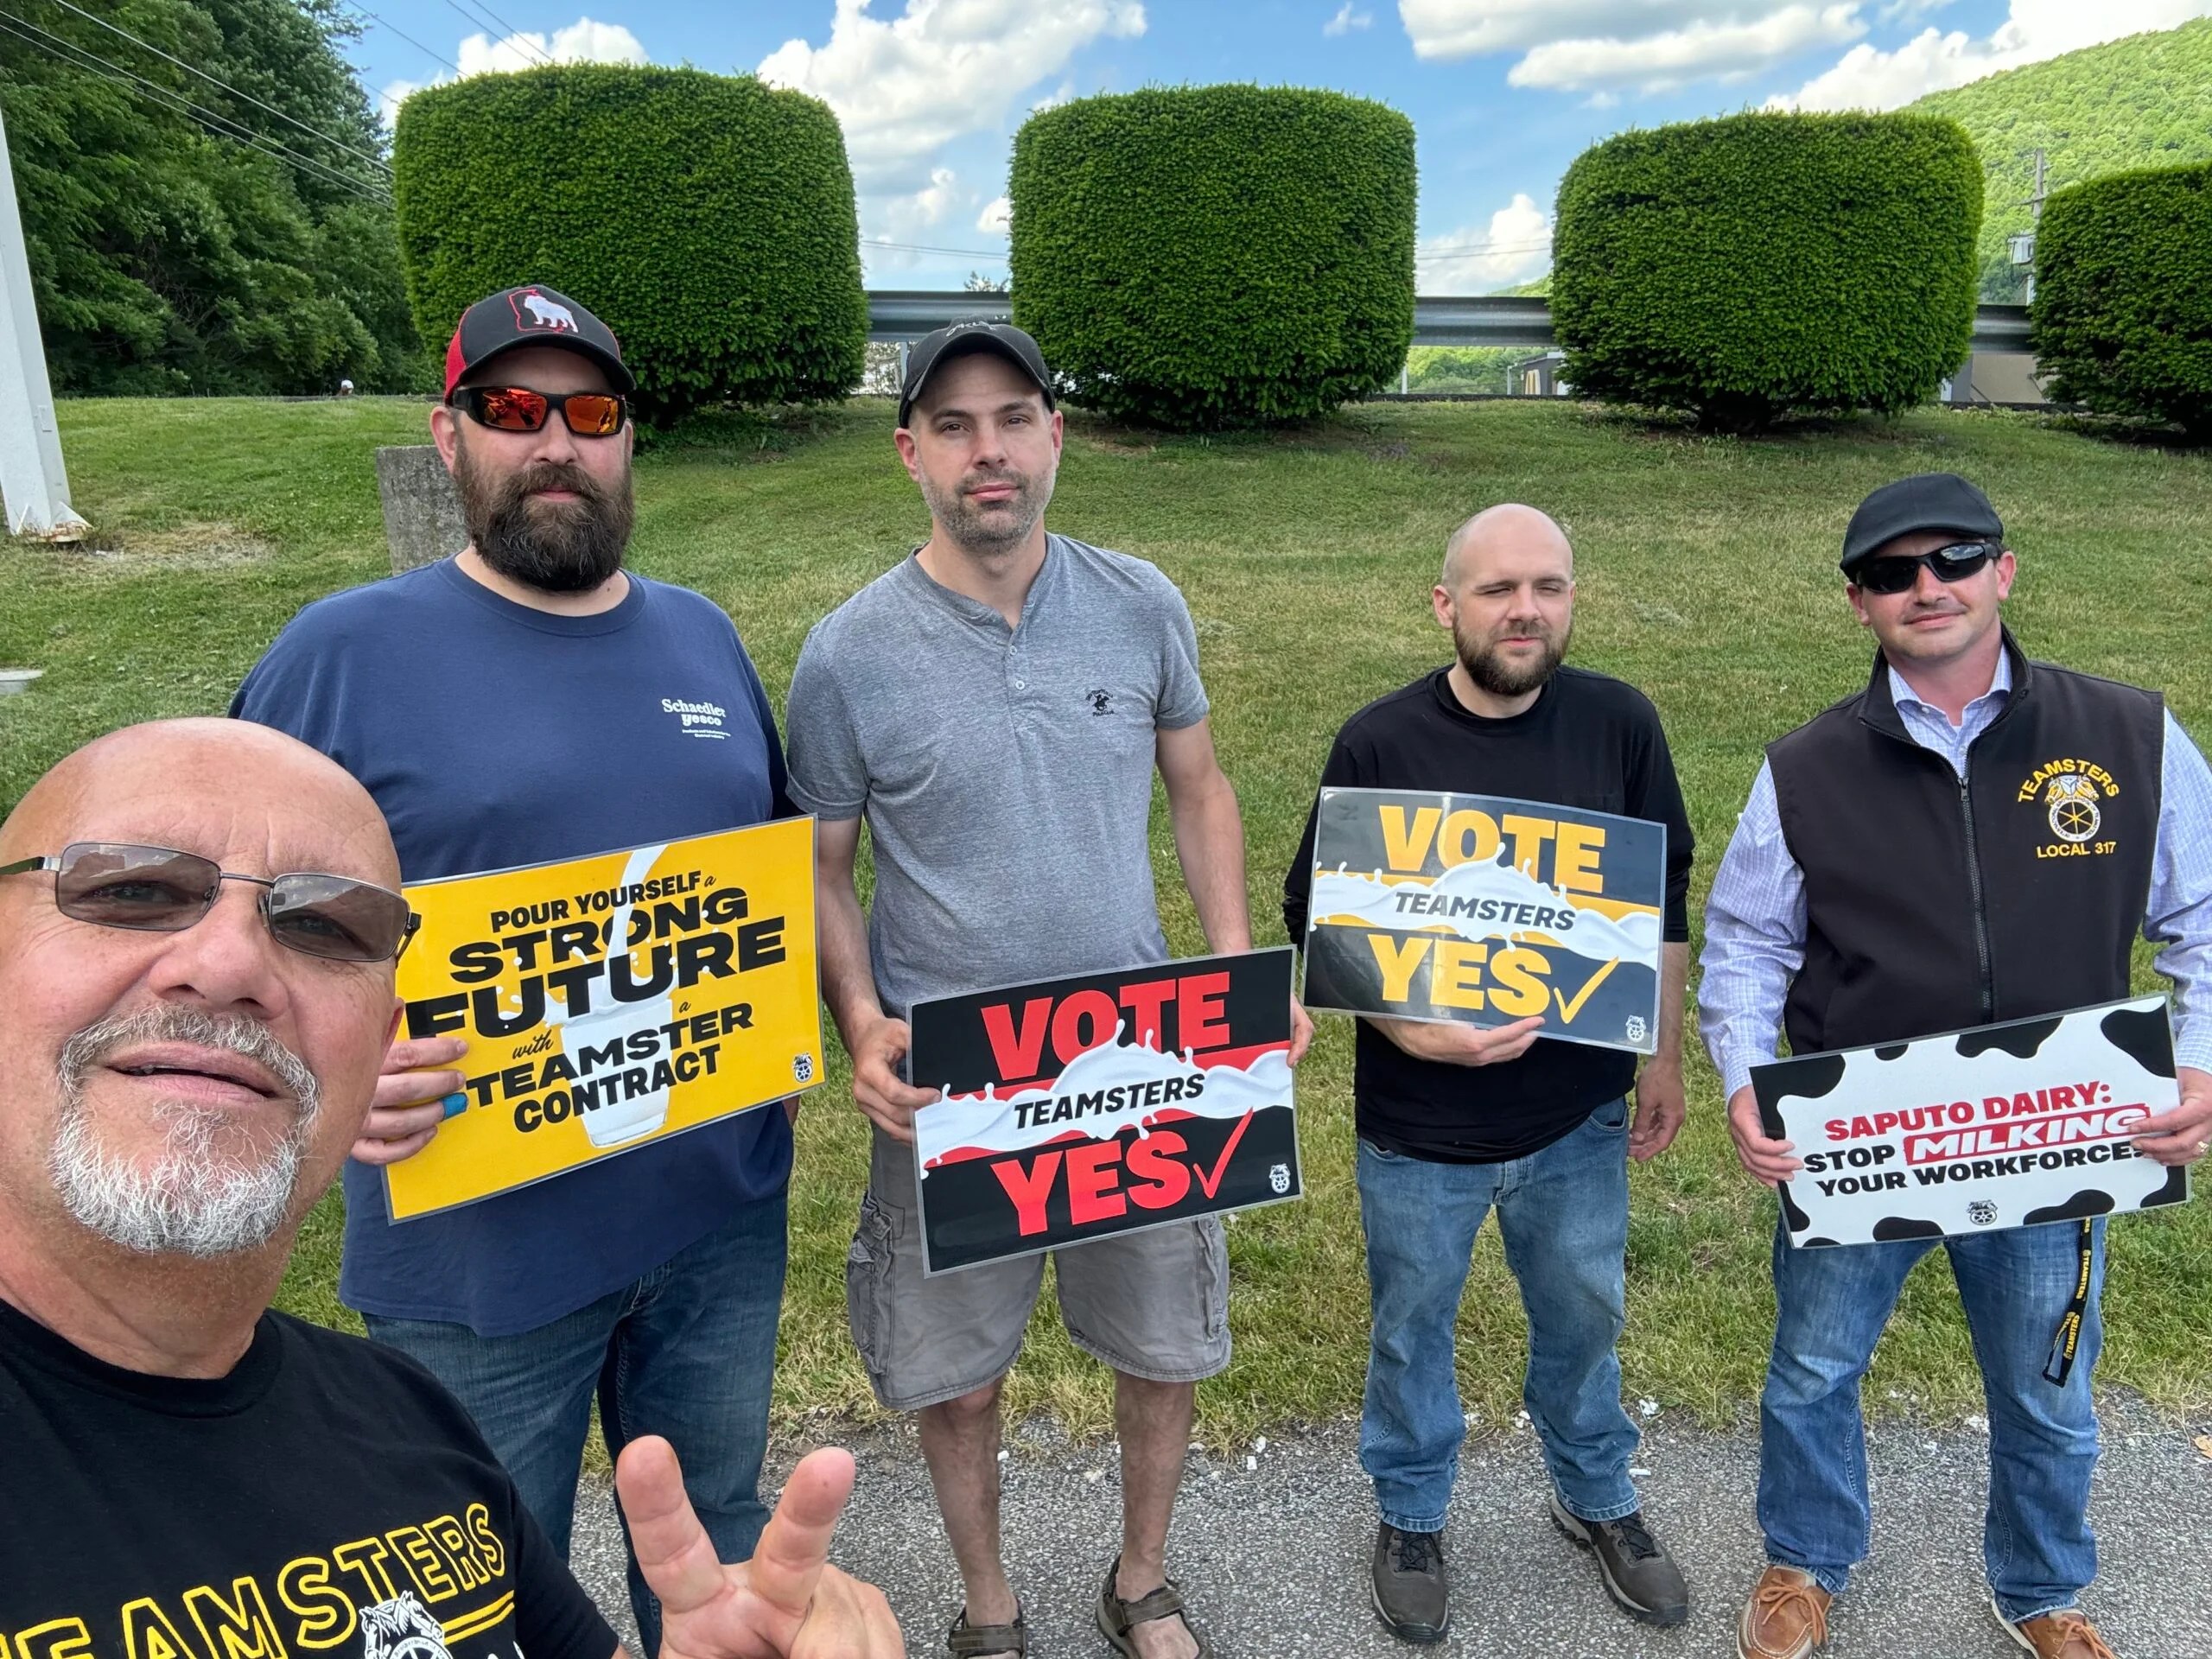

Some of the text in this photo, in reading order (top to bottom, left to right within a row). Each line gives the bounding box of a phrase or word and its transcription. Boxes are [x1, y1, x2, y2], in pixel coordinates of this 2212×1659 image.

[661, 698, 726, 717] Schaedler
[2018, 758, 2120, 803] TEAMSTERS
[1379, 805, 1605, 893] VOTE
[2037, 841, 2117, 858] LOCAL 317
[491, 870, 716, 933] POUR YOURSELF a
[1395, 892, 1576, 931] TEAMSTERS
[449, 887, 748, 983] STRONG
[405, 916, 786, 1039] FUTURE
[1368, 934, 1552, 1017] YES
[466, 1002, 753, 1107] TEAMSTER
[512, 1001, 691, 1059] with a
[981, 971, 1230, 1081] VOTE
[513, 1044, 721, 1133] CONTRACT
[1014, 1073, 1205, 1129] TEAMSTERS
[1825, 1081, 2112, 1141] SAPUTO DAIRY:
[1804, 1108, 2147, 1173] STOP MILKING
[990, 1131, 1191, 1236] YES
[1815, 1171, 1908, 1197] YOUR
